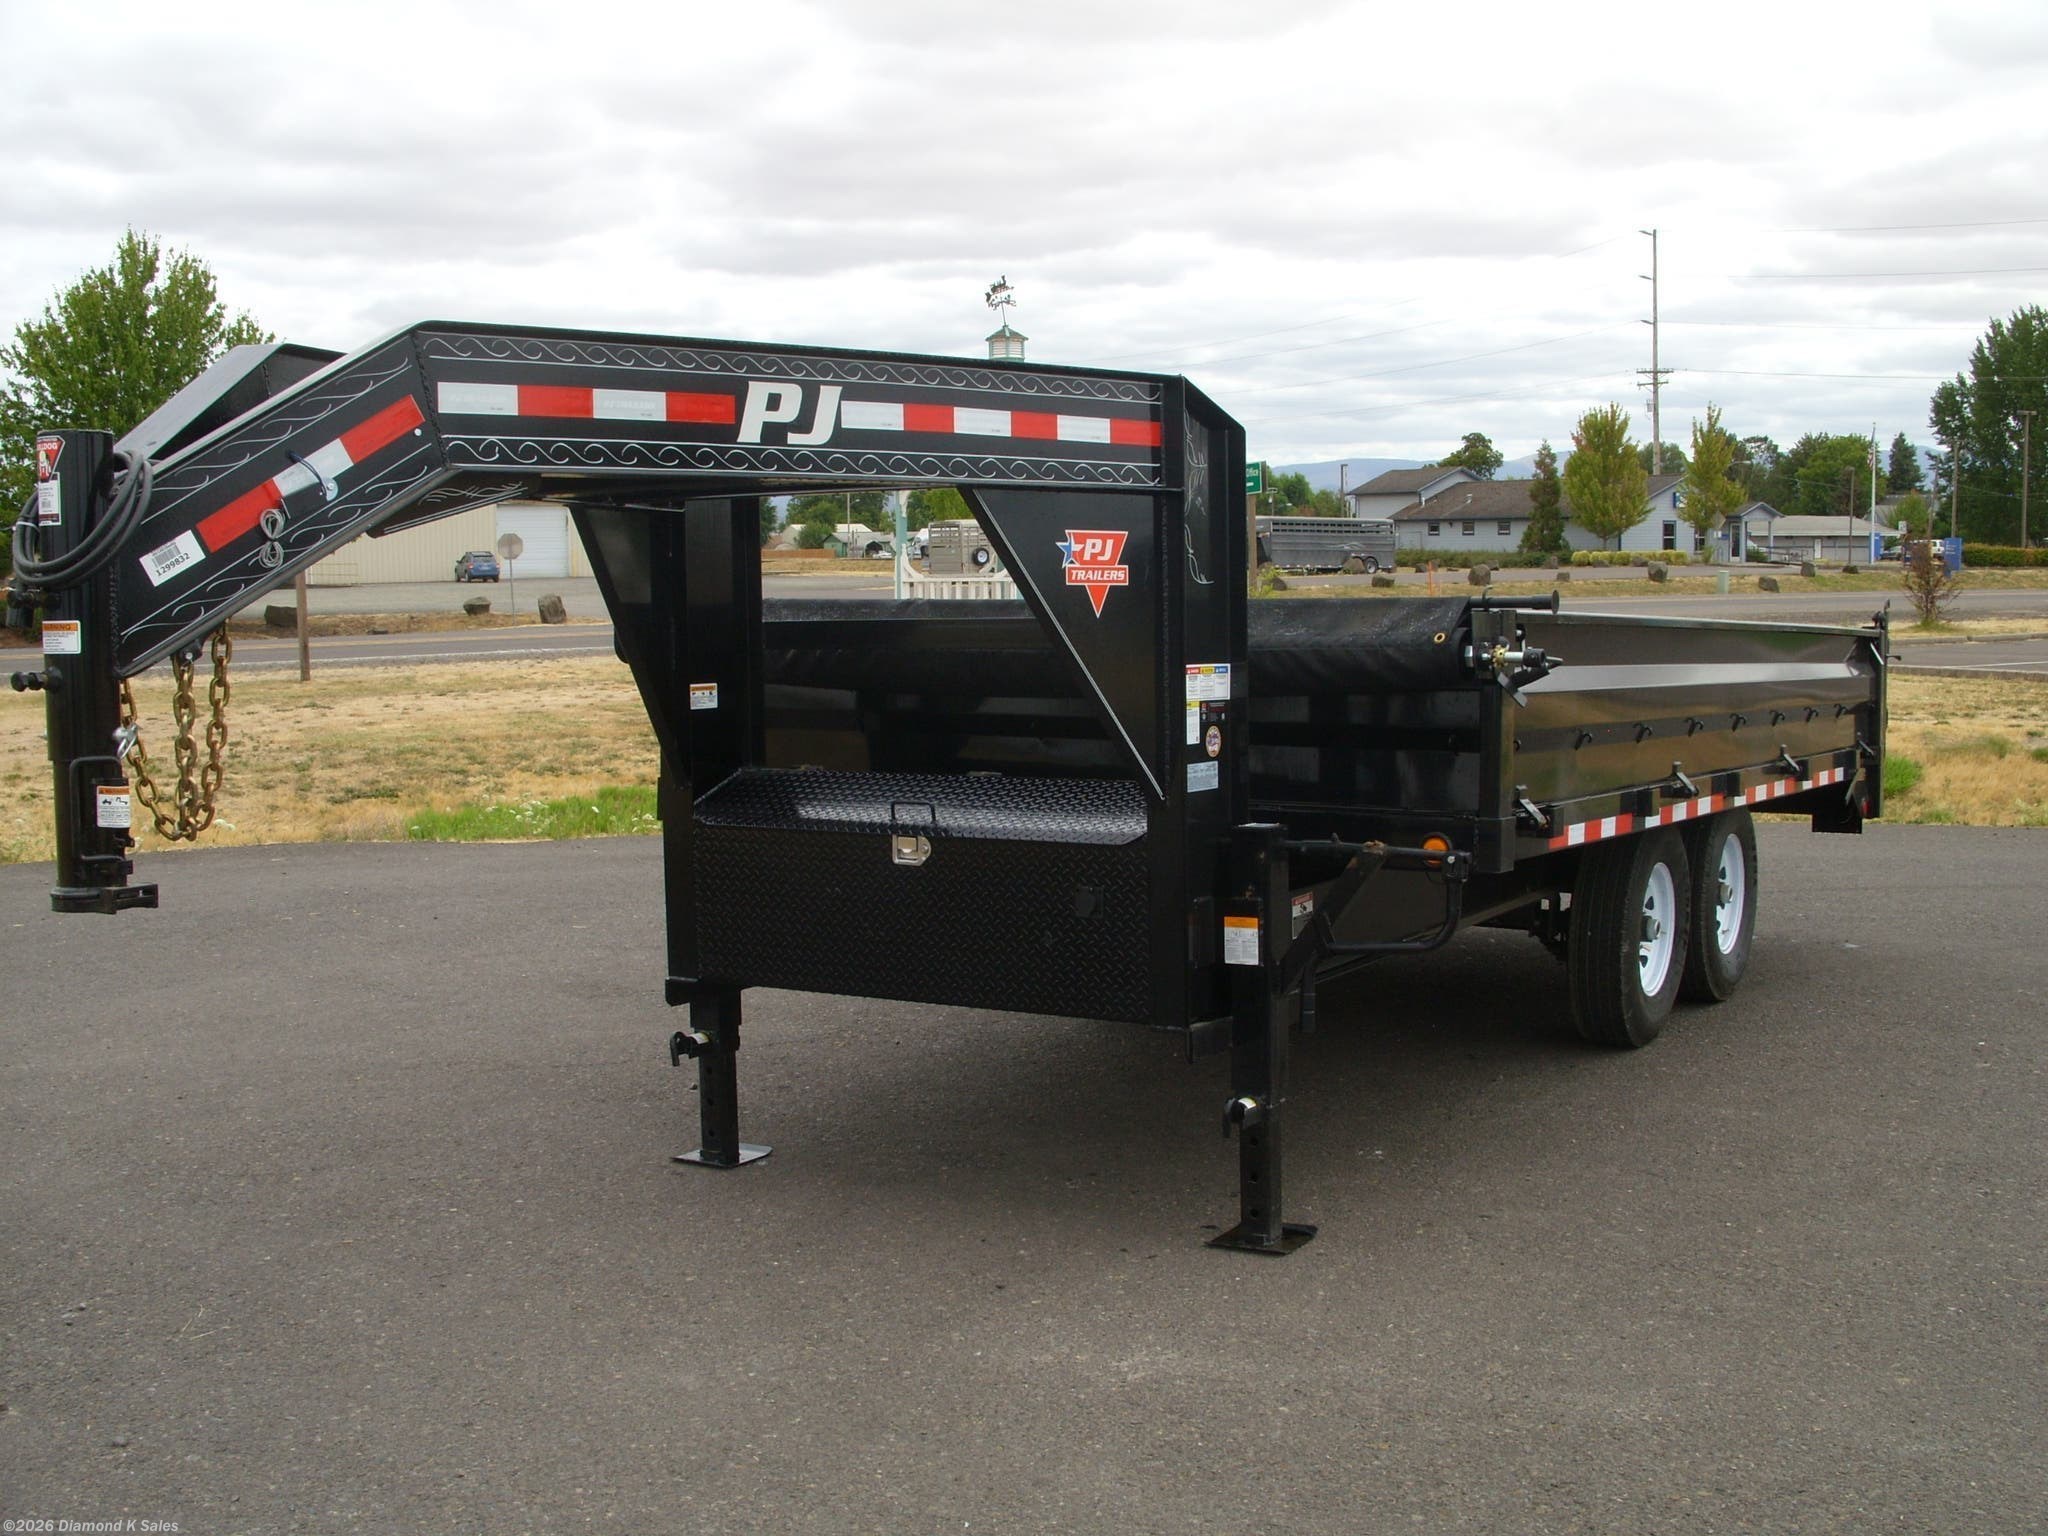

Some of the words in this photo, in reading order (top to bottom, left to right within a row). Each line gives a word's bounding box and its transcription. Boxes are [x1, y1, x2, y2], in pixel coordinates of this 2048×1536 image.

[737, 381, 843, 446] PJ
[1083, 538, 1114, 561] PJ
[155, 552, 191, 577] 1299832
[1071, 569, 1126, 581] TRAILERS
